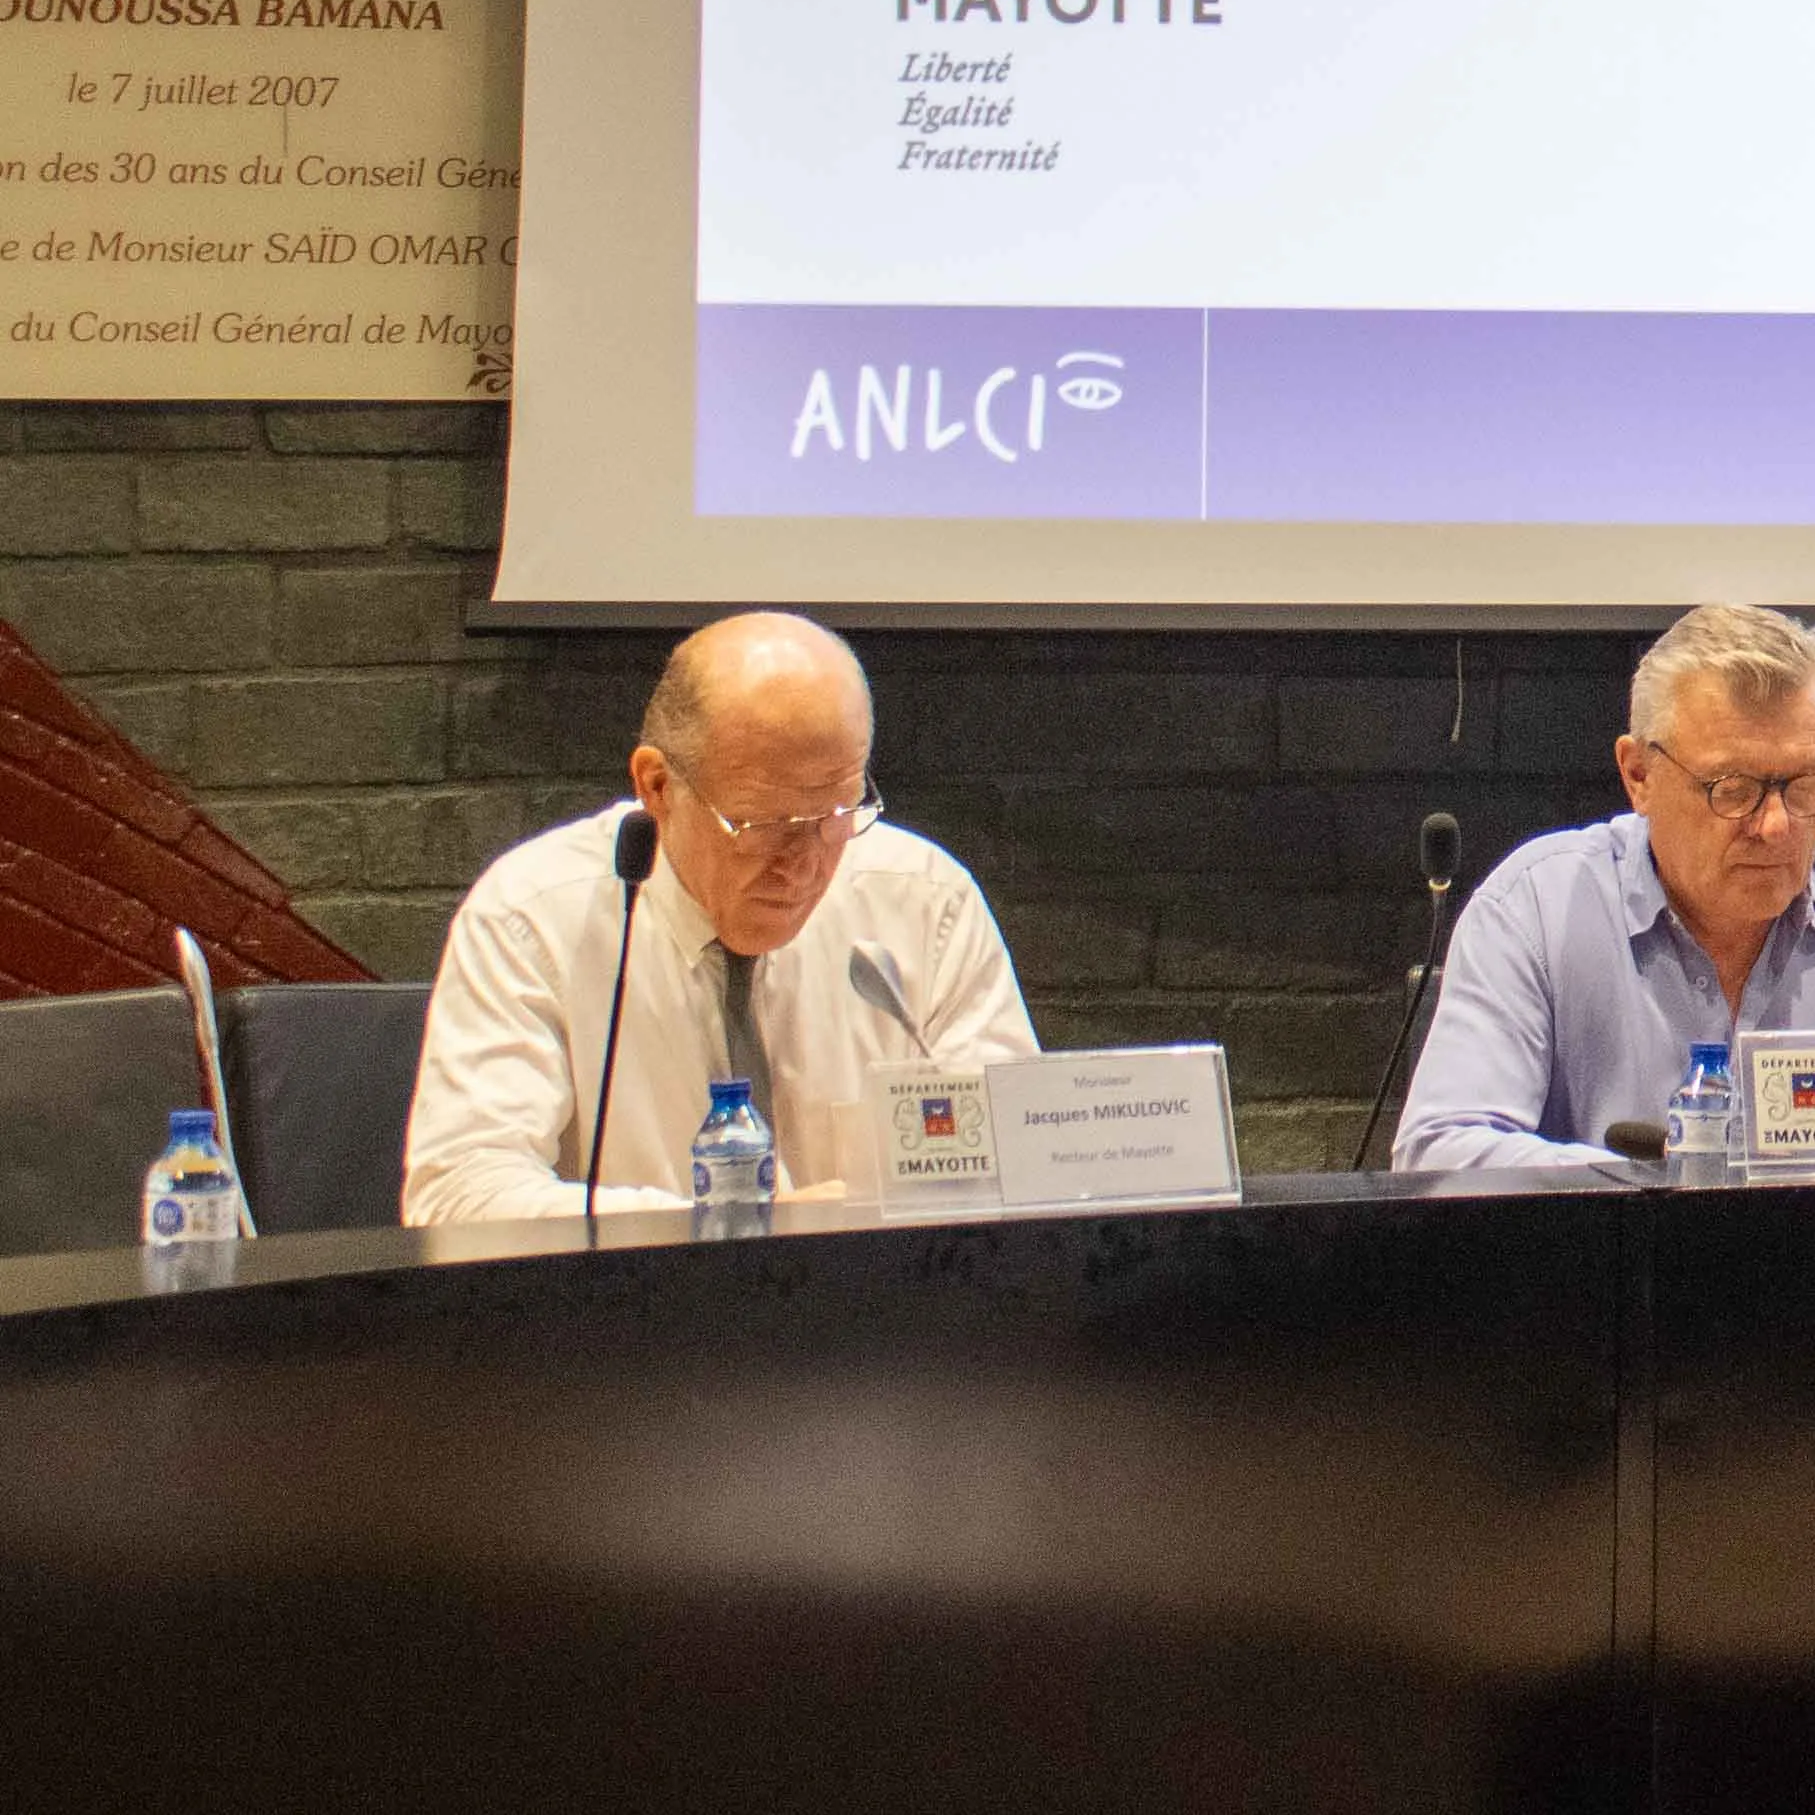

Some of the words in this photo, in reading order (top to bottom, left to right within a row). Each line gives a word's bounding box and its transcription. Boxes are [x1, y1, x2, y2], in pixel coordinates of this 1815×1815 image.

[899, 52, 1012, 83] Liberté
[67, 73, 98, 104] le
[112, 74, 131, 103] 7
[138, 76, 238, 111] juillet
[249, 78, 339, 107] 2007
[898, 91, 1013, 134] Égalité
[40, 151, 98, 183] des
[110, 153, 156, 183] 30
[169, 161, 226, 185] ans
[239, 156, 282, 185] du
[297, 156, 424, 187] Conseil
[898, 141, 1060, 171] Fraternité
[33, 232, 75, 262] de
[87, 231, 253, 263] Monsieur
[264, 226, 356, 265] SAÏD
[370, 233, 487, 266] OMAR
[11, 311, 55, 342] du
[69, 312, 201, 343] Conseil
[213, 312, 352, 344] Général
[365, 313, 405, 344] de
[790, 365, 1046, 462] ANLCI
[1024, 1108, 1088, 1127] Jacques
[1094, 1099, 1192, 1121] MIKULOVIC
[908, 1156, 990, 1173] MAYOTTE
